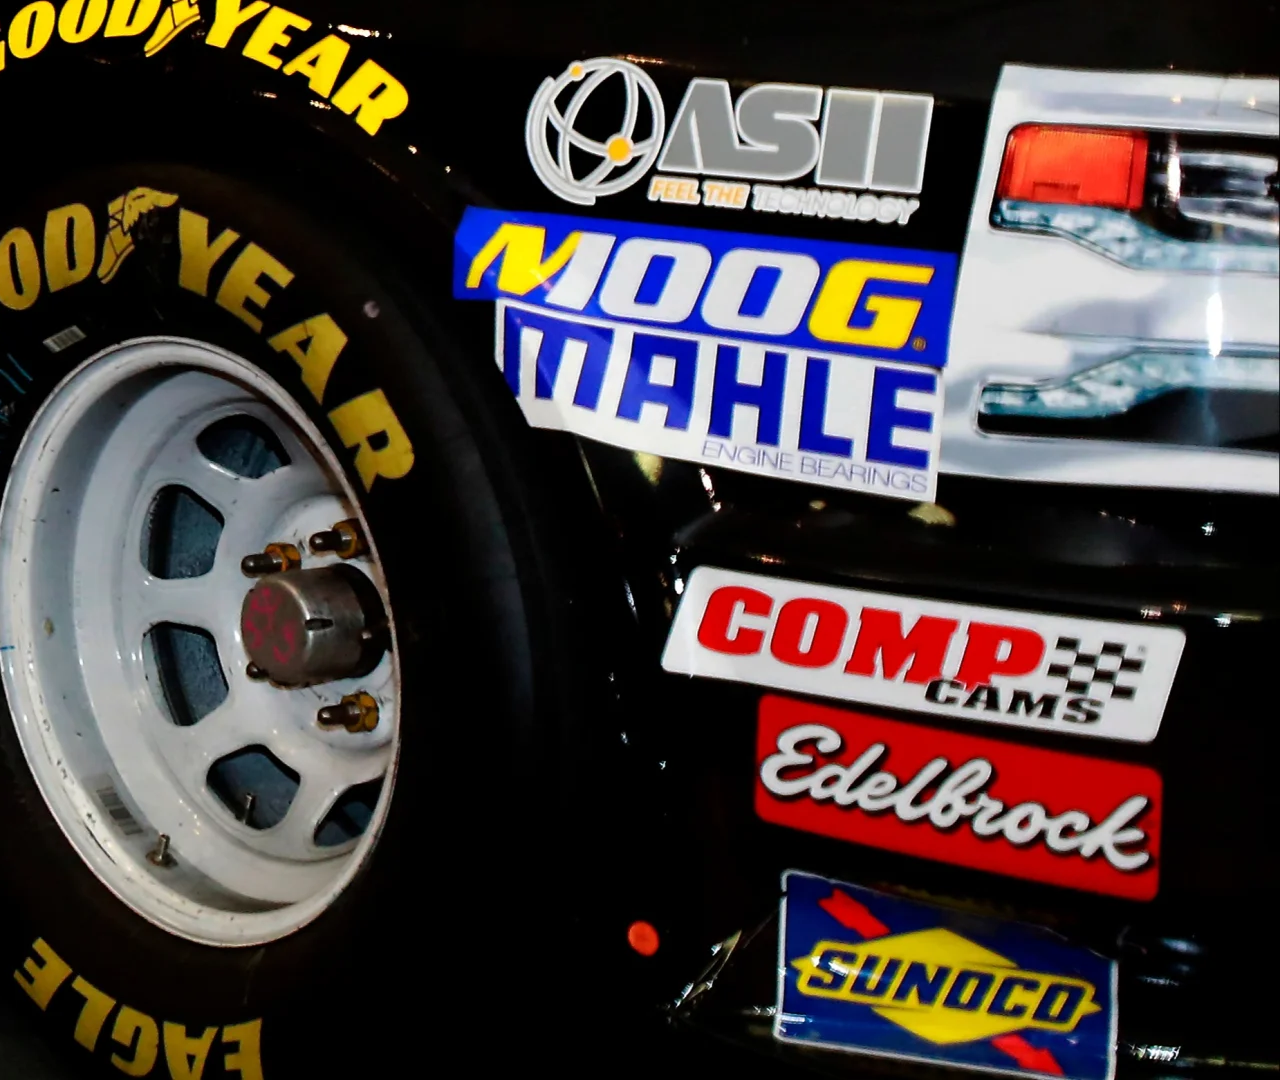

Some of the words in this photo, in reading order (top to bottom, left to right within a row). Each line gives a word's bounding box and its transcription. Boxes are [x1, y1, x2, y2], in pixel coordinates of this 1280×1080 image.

[648, 178, 702, 206] FEEL
[704, 181, 750, 210] THE
[751, 185, 920, 227] TECHNOLOGY
[465, 222, 936, 350] MOOG
[504, 305, 940, 472] MAHLE
[701, 439, 794, 473] ENGINE
[798, 453, 929, 495] BEARINGS
[696, 584, 1048, 689] COMP
[923, 677, 1106, 726] CAMS
[759, 722, 1152, 872] Edelbrock
[13, 936, 265, 1080] EAGLE
[805, 949, 1090, 1024] SUNOCO
